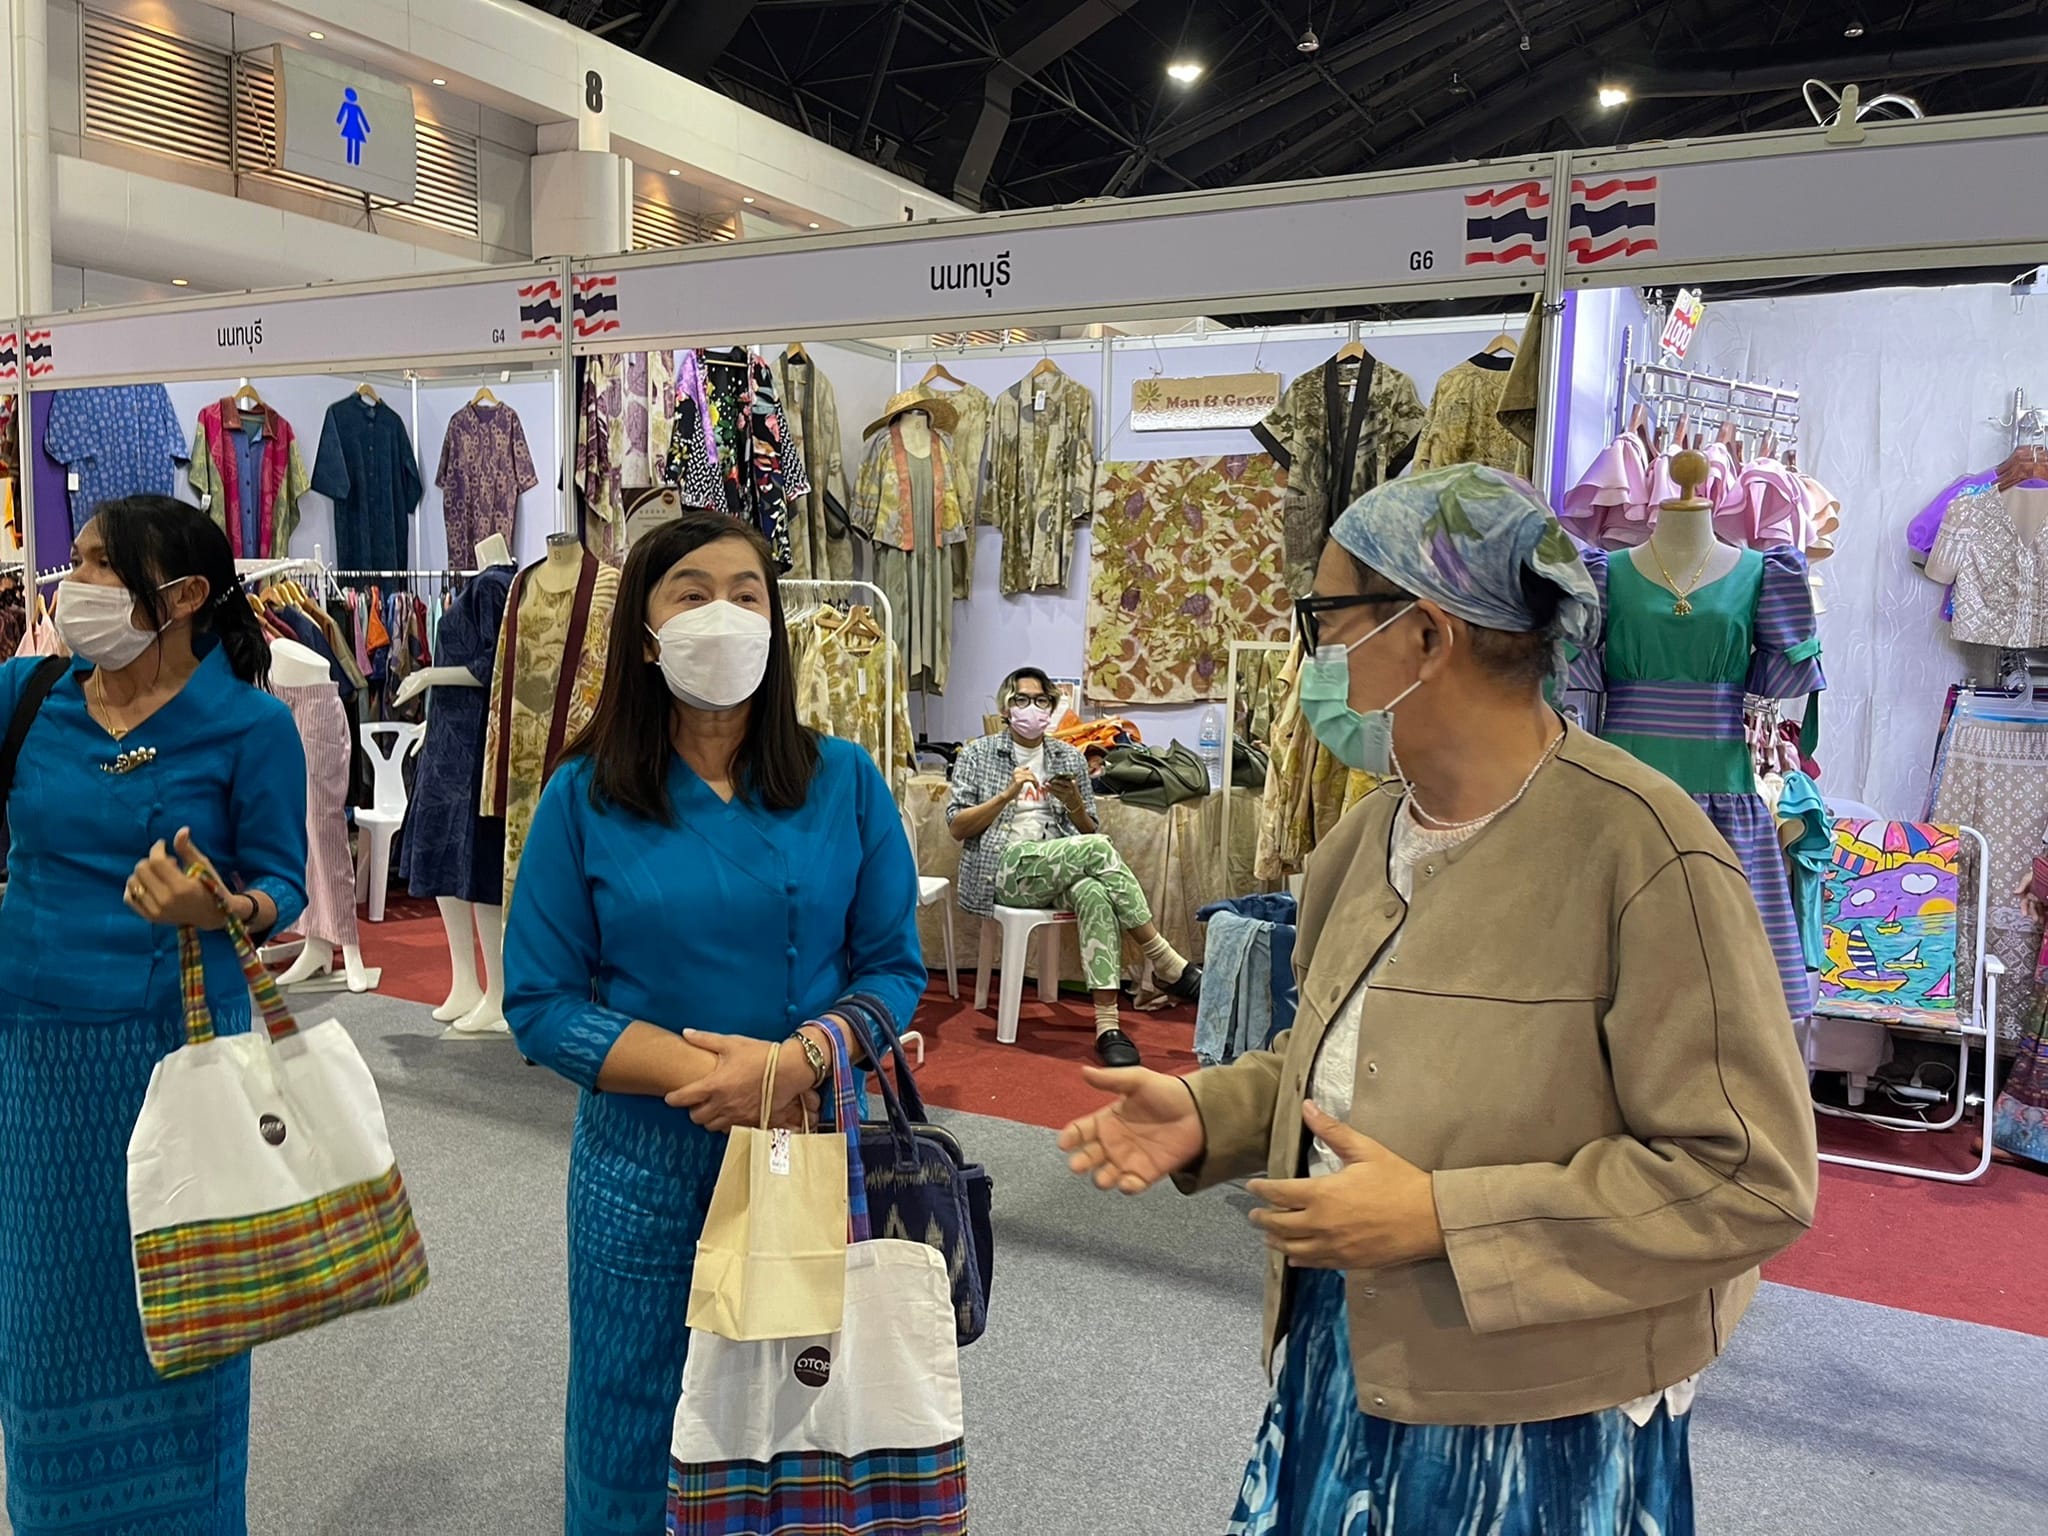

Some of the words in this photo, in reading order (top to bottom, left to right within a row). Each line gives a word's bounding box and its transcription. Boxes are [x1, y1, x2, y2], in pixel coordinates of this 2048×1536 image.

[585, 70, 603, 113] 8
[930, 250, 1010, 298] นนทบุรี
[1410, 250, 1433, 270] G6
[217, 318, 263, 354] นนทบุรี
[492, 328, 505, 343] G4
[1166, 396, 1200, 409] Man
[1223, 394, 1276, 407] Grove
